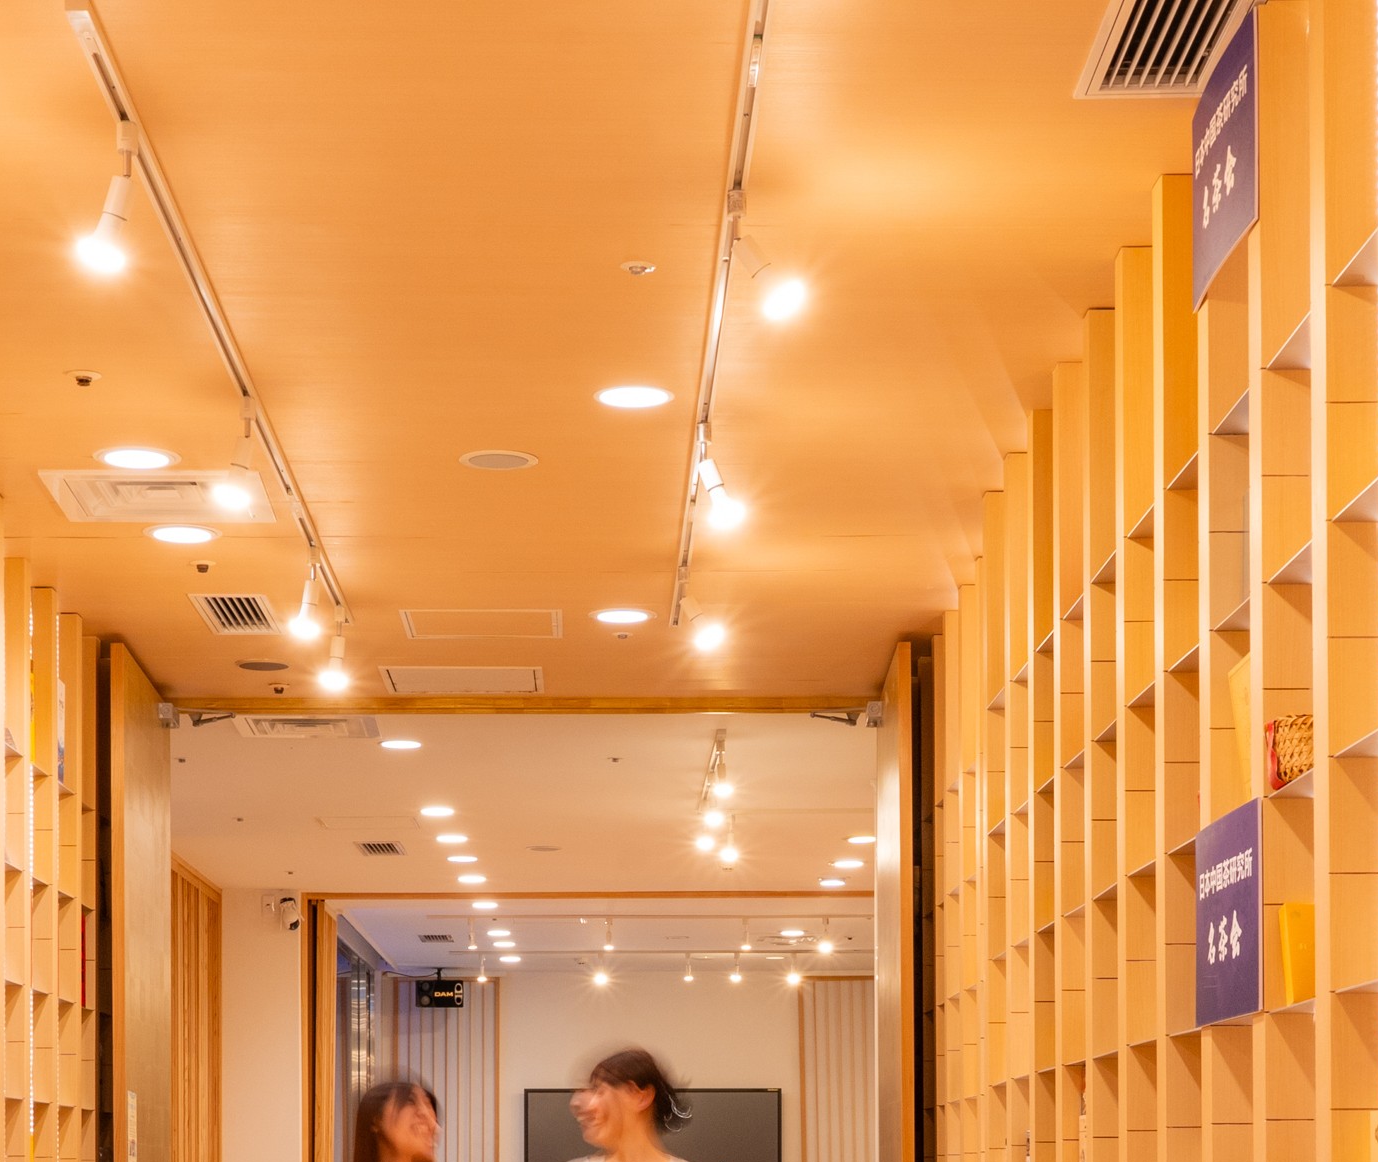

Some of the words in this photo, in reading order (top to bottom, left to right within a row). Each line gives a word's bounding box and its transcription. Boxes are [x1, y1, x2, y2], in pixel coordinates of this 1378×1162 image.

[1199, 847, 1253, 901] 日本中国茶研究所
